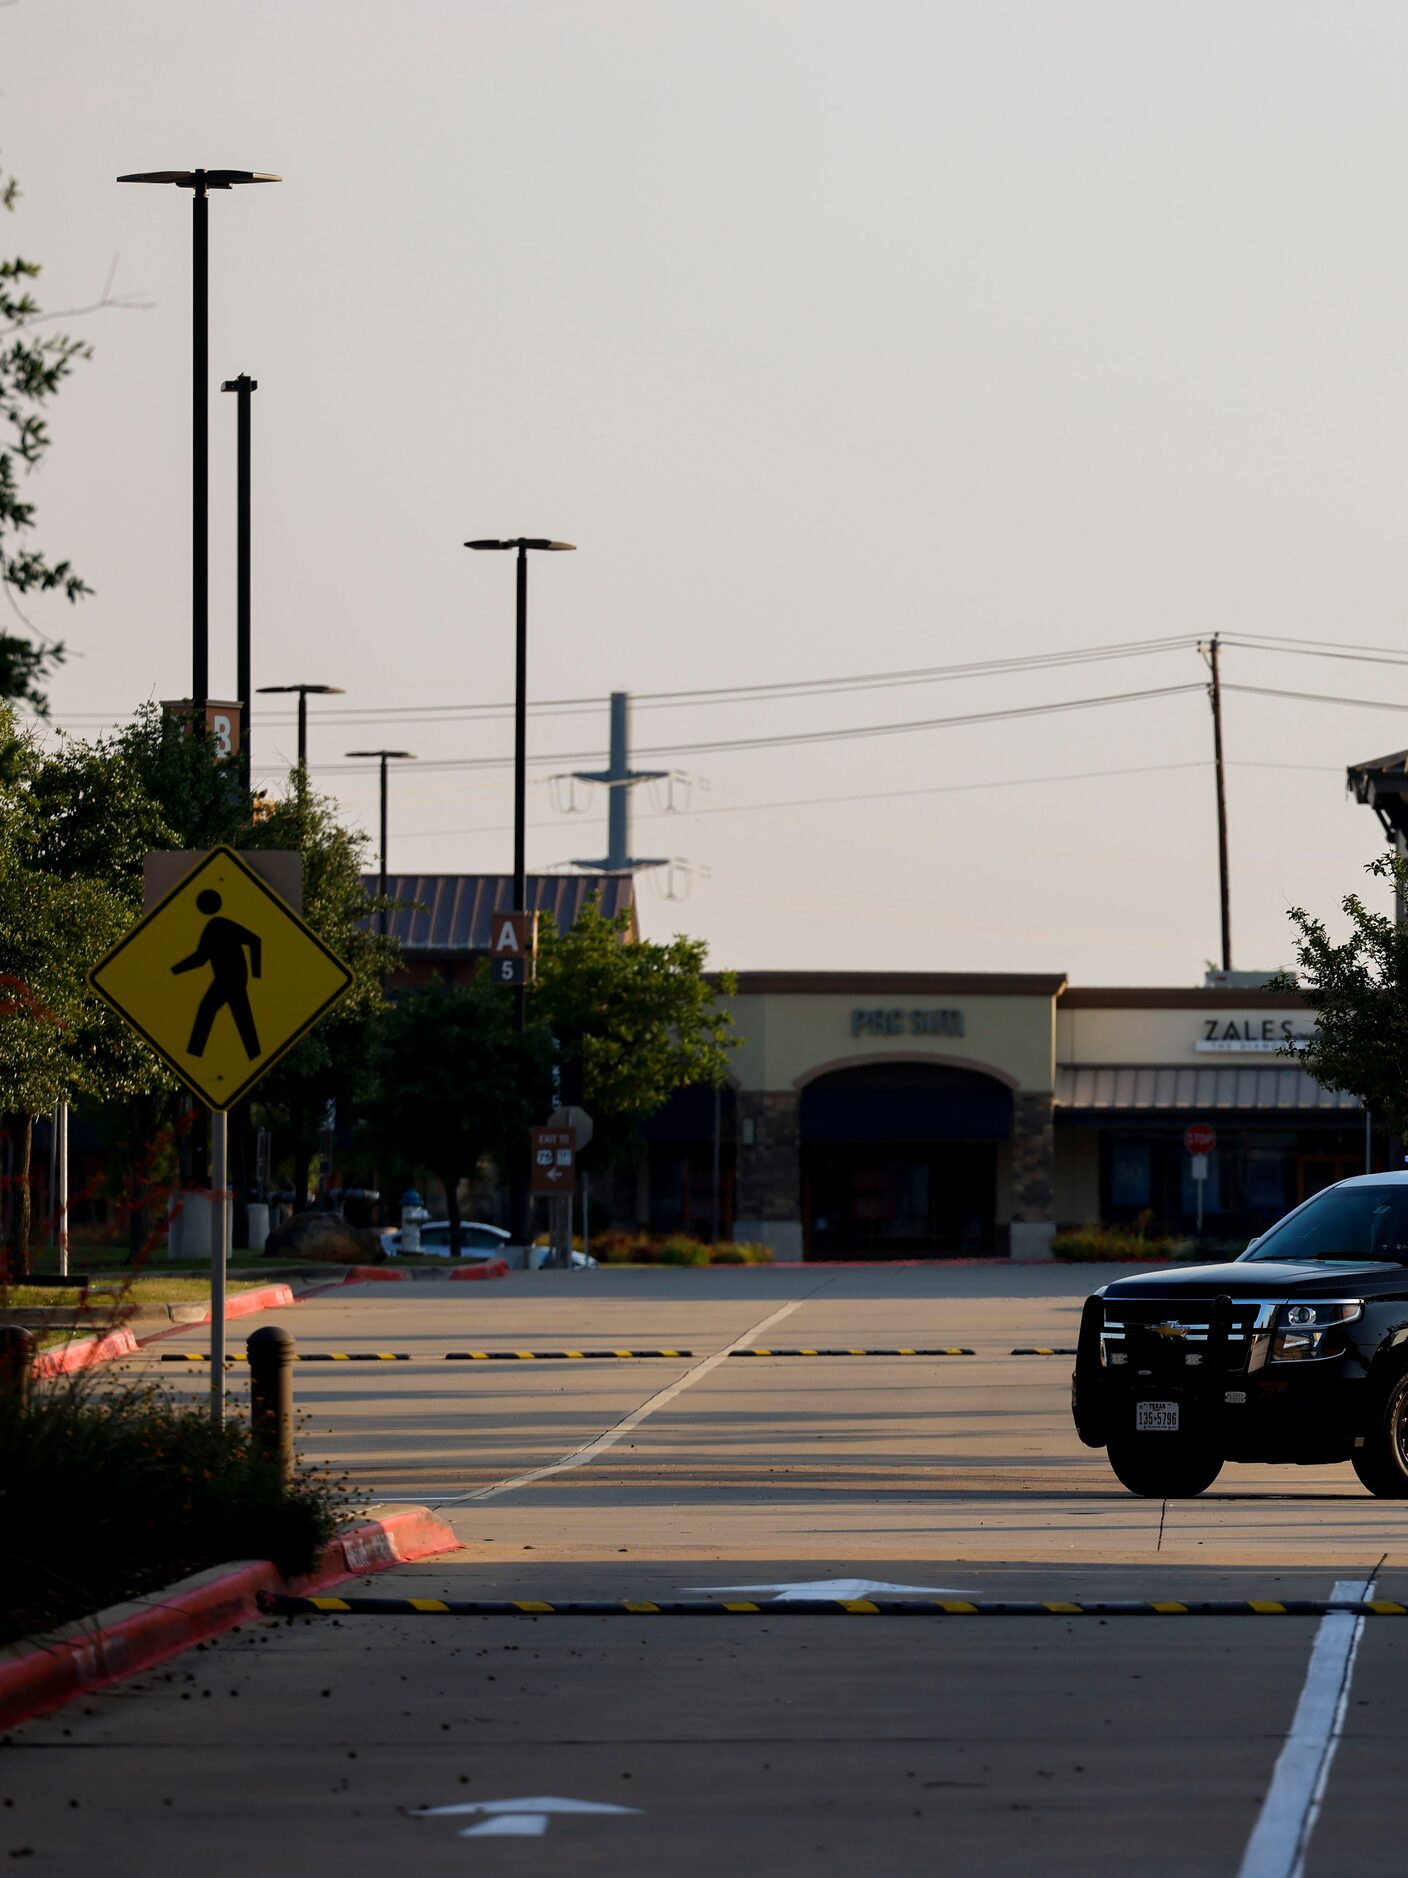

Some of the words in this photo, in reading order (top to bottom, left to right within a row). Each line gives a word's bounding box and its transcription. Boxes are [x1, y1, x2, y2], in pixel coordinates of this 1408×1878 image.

[214, 715, 232, 758] B
[496, 921, 519, 952] A
[501, 961, 514, 980] 5
[1204, 1019, 1293, 1041] ZALES
[1186, 1132, 1215, 1145] STOP
